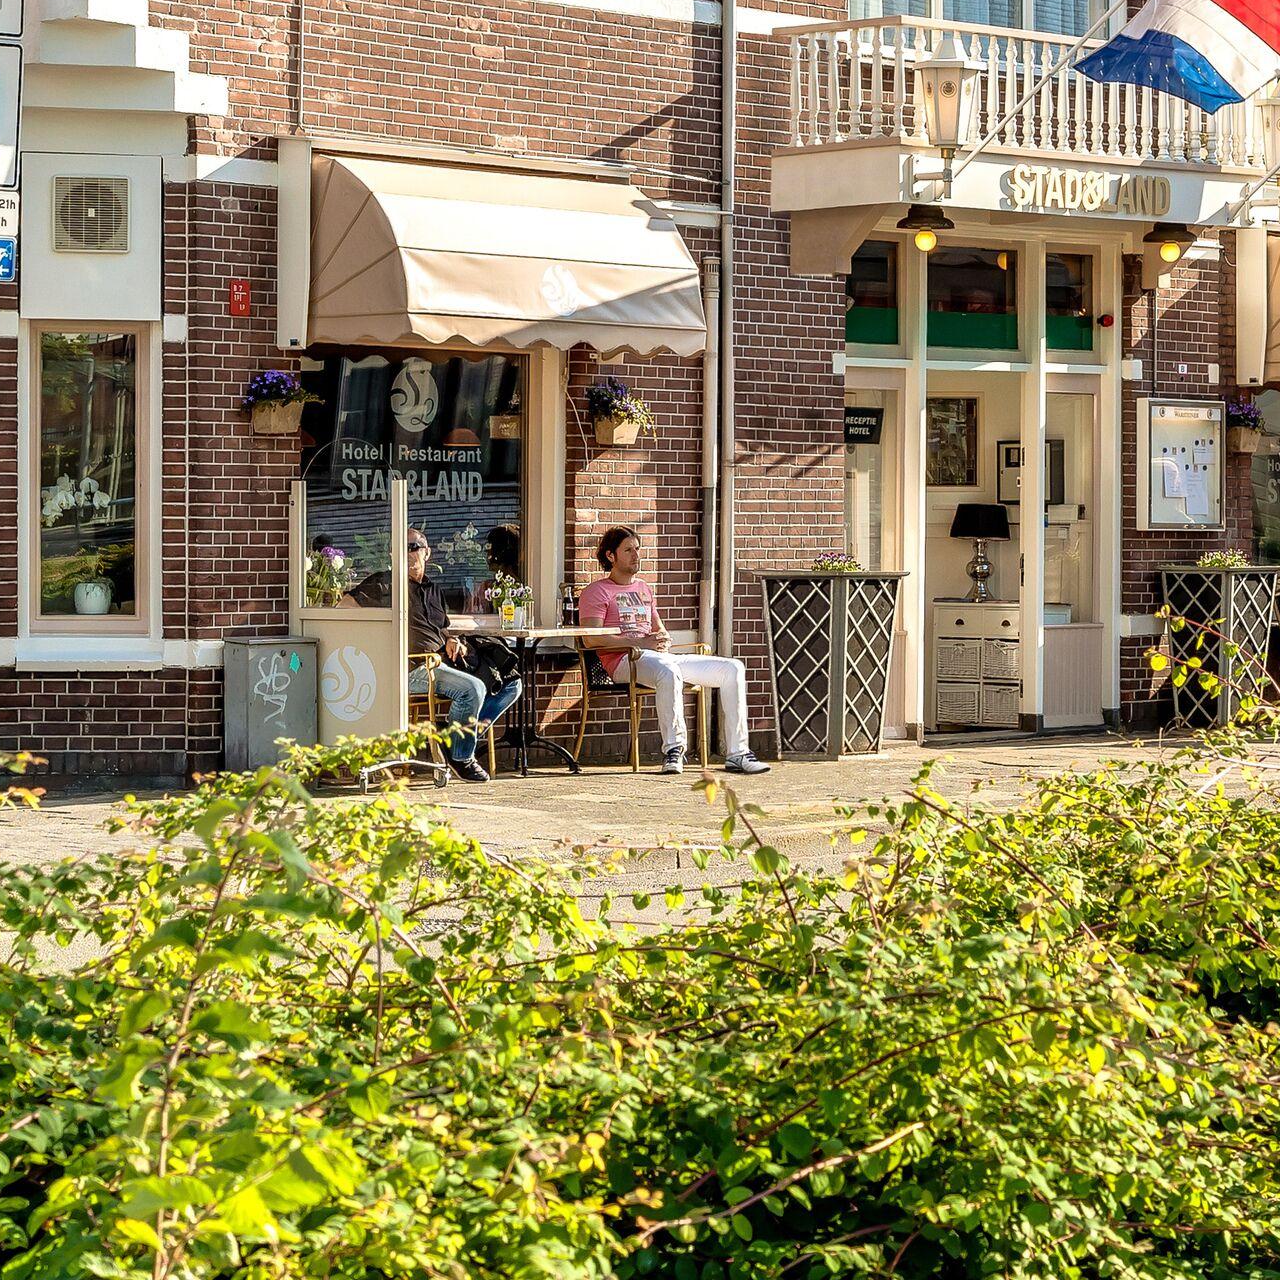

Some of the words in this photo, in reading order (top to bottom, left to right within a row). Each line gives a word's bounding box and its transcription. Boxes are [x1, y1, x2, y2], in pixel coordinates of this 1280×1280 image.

[1013, 164, 1172, 216] STAD&LAND
[845, 416, 877, 426] RECEPTIE
[849, 427, 870, 435] HOTEL
[342, 444, 384, 460] Hotel
[398, 445, 482, 463] Restaurant
